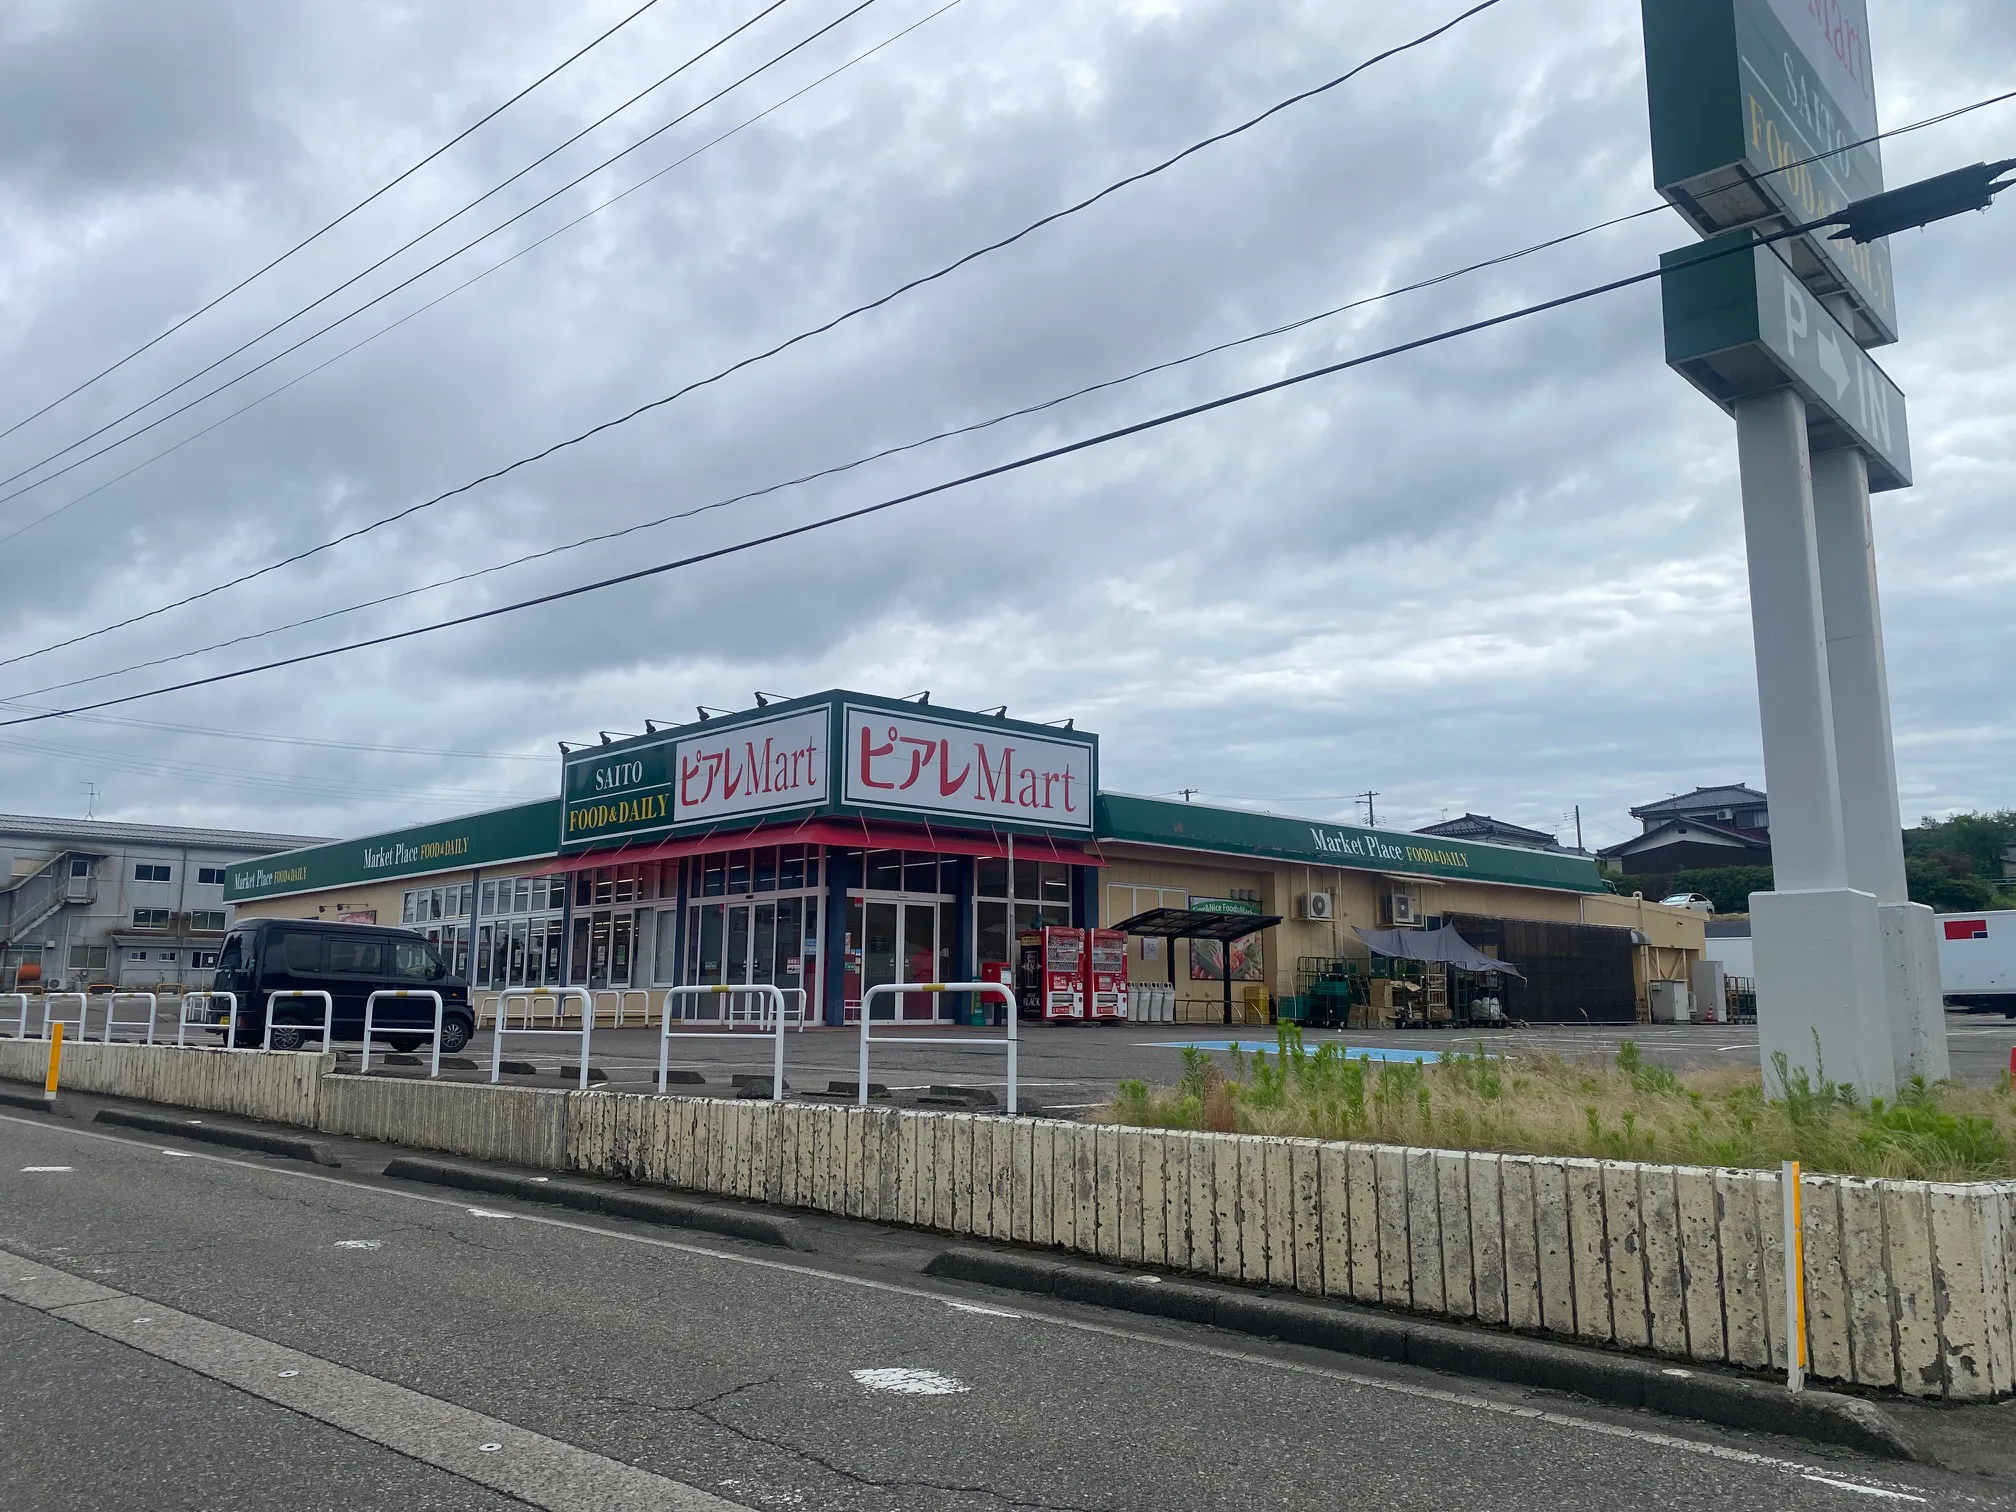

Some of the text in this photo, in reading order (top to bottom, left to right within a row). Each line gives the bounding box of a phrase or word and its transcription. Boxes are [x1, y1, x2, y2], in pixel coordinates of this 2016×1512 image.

[1783, 52, 1850, 178] SAITO
[1782, 273, 1892, 455] P IN
[595, 760, 643, 791] SAITO
[568, 793, 670, 832] FOOD&DAILY
[362, 837, 470, 869] Market Place FOOD&DAILY
[1309, 827, 1469, 868] Market Place FOOD&DAILY
[233, 866, 308, 891] Market Place FOOD&DAILY
